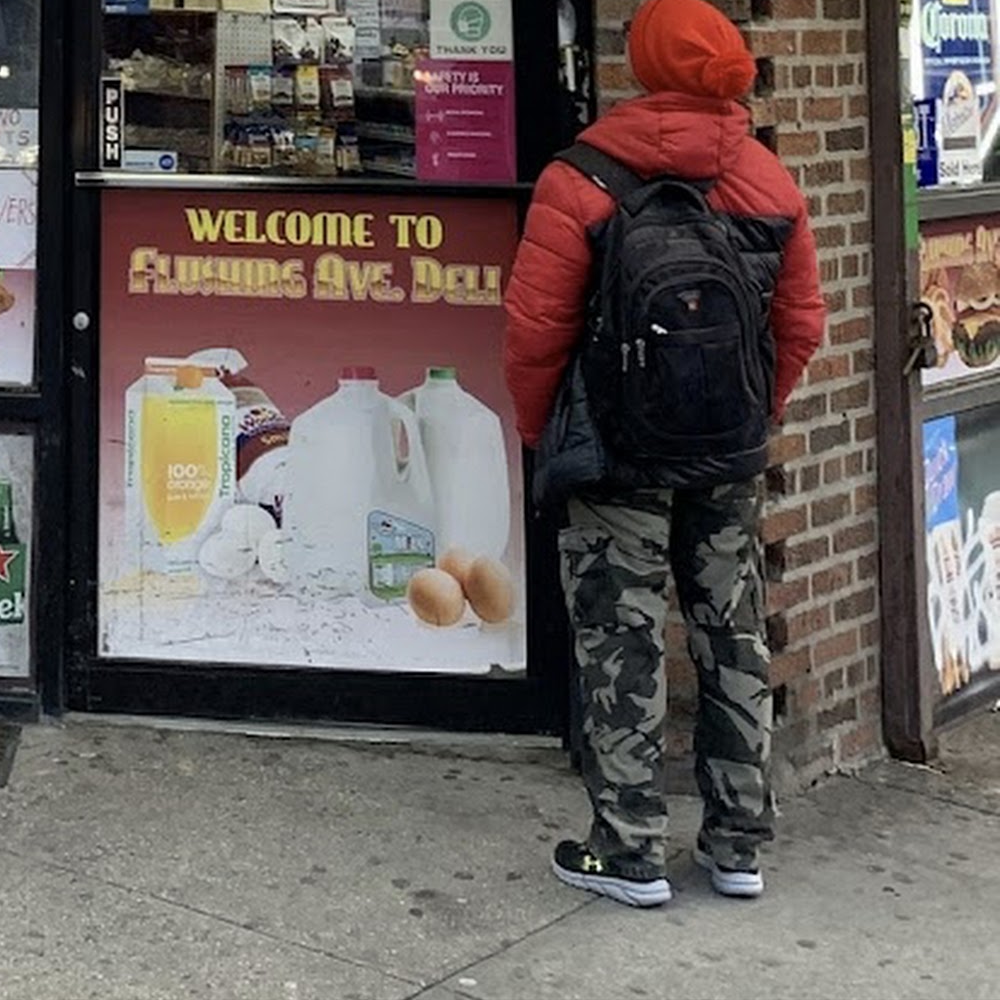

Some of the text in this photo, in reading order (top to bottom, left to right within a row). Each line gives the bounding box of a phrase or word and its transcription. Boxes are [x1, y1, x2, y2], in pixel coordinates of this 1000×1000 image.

[452, 84, 504, 96] PRIORITY
[105, 87, 119, 161] PUSH
[185, 208, 444, 249] WELCOME TO
[410, 255, 502, 306] DELI
[219, 414, 233, 498] Tropicana
